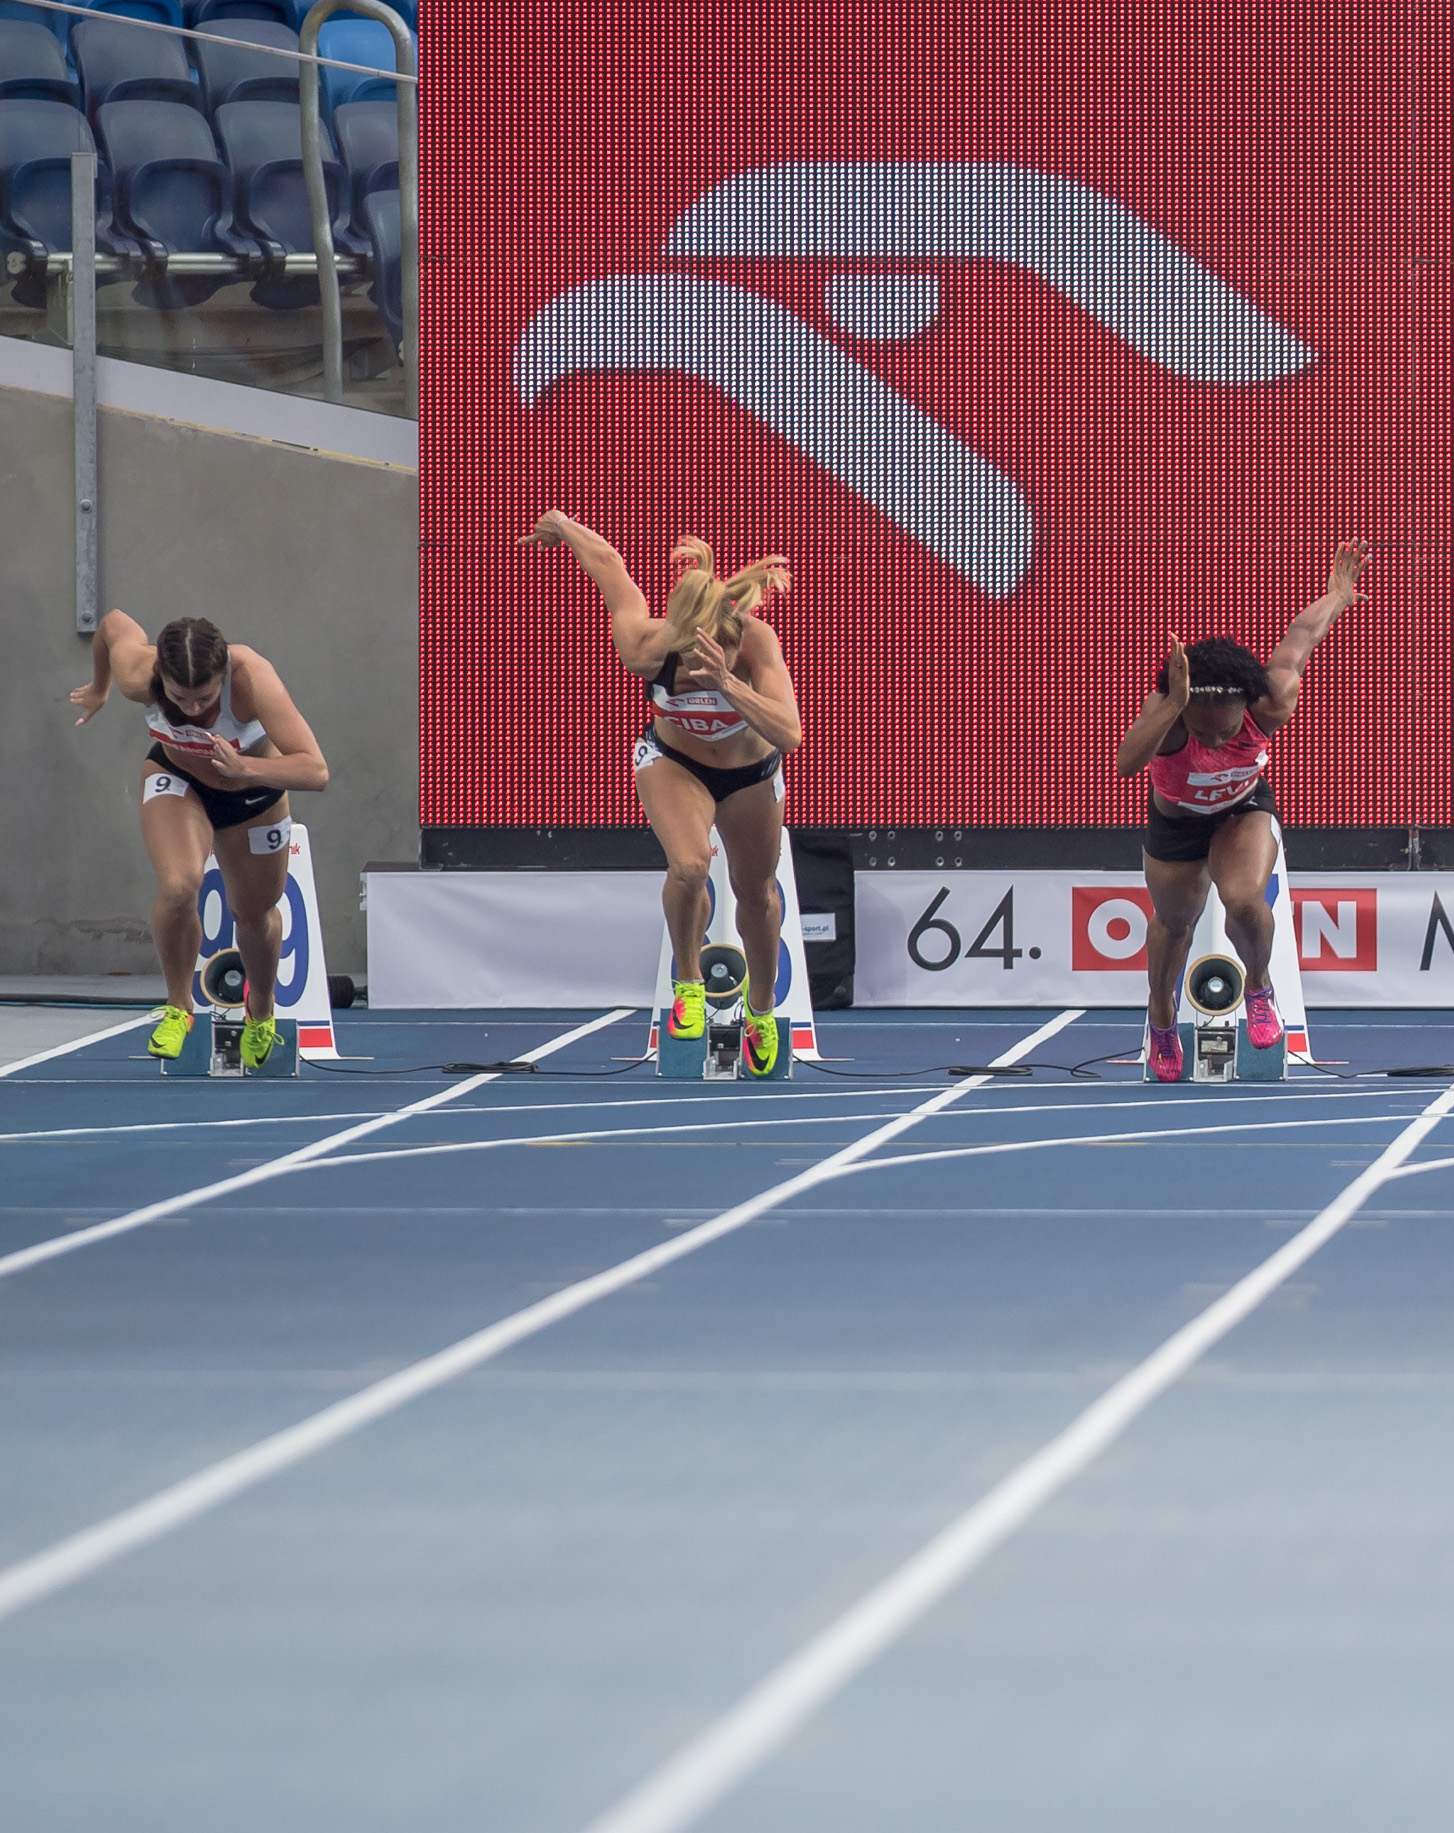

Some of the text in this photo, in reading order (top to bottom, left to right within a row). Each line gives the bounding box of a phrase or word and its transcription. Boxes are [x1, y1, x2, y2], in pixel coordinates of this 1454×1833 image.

[663, 715, 729, 731] CIBA
[155, 776, 171, 793] 9
[266, 829, 283, 850] 9
[907, 884, 1042, 971] 64.
